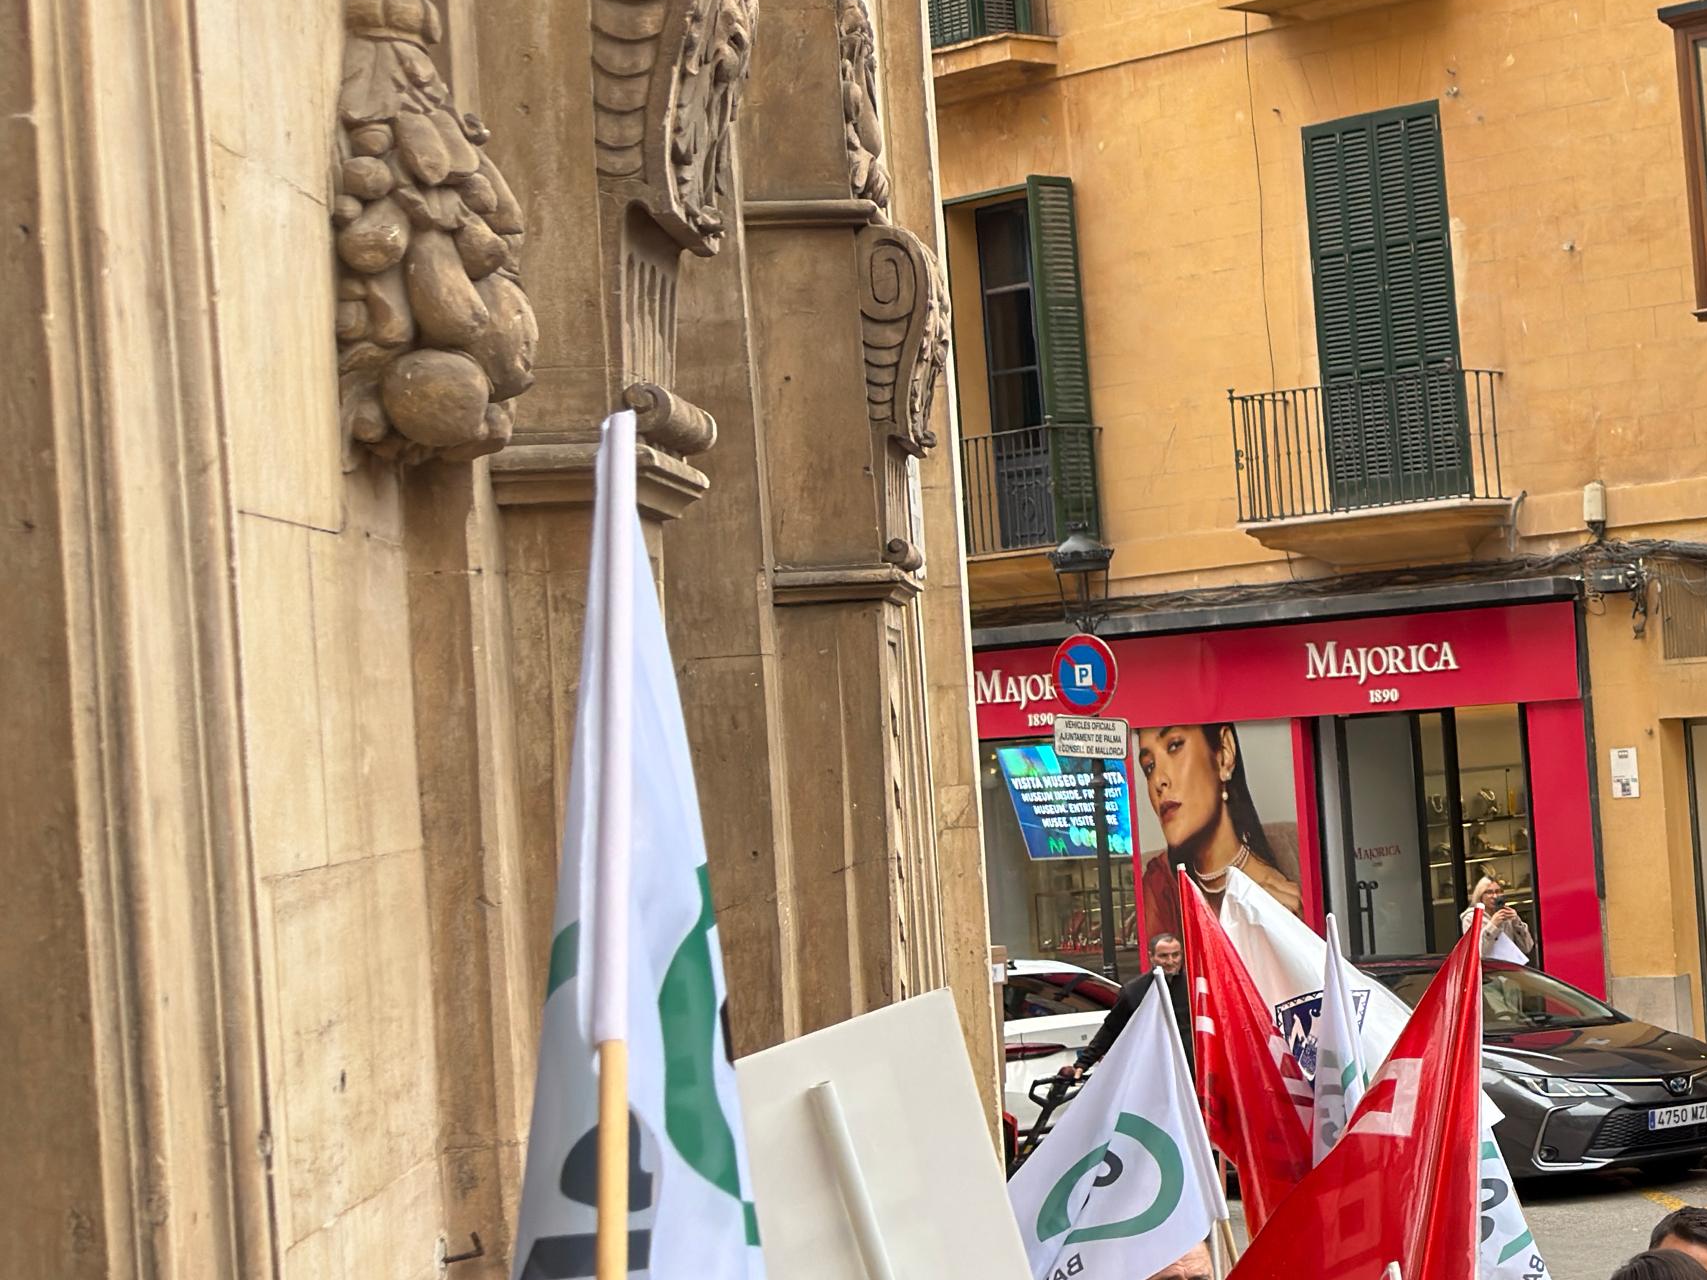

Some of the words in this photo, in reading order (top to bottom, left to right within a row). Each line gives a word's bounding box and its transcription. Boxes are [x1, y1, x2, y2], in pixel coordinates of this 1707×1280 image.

[975, 669, 1058, 711] MAJOR
[1368, 688, 1400, 704] 1890
[1026, 712, 1055, 728] 1890
[1064, 720, 1091, 730] VEHICLES
[1091, 721, 1116, 732] OFICIALS
[1059, 732, 1095, 744] AJUNTAMENT
[1095, 733, 1104, 743] DE
[1103, 734, 1122, 745] PALMA
[1061, 744, 1086, 754] CONSELL
[1086, 746, 1095, 755] DE
[1095, 746, 1124, 757] MALLORCA
[1011, 775, 1043, 791] VISITA
[1044, 774, 1077, 789] MUSEO
[1021, 791, 1053, 803] MUSEUM
[1658, 1108, 1688, 1126] 4750
